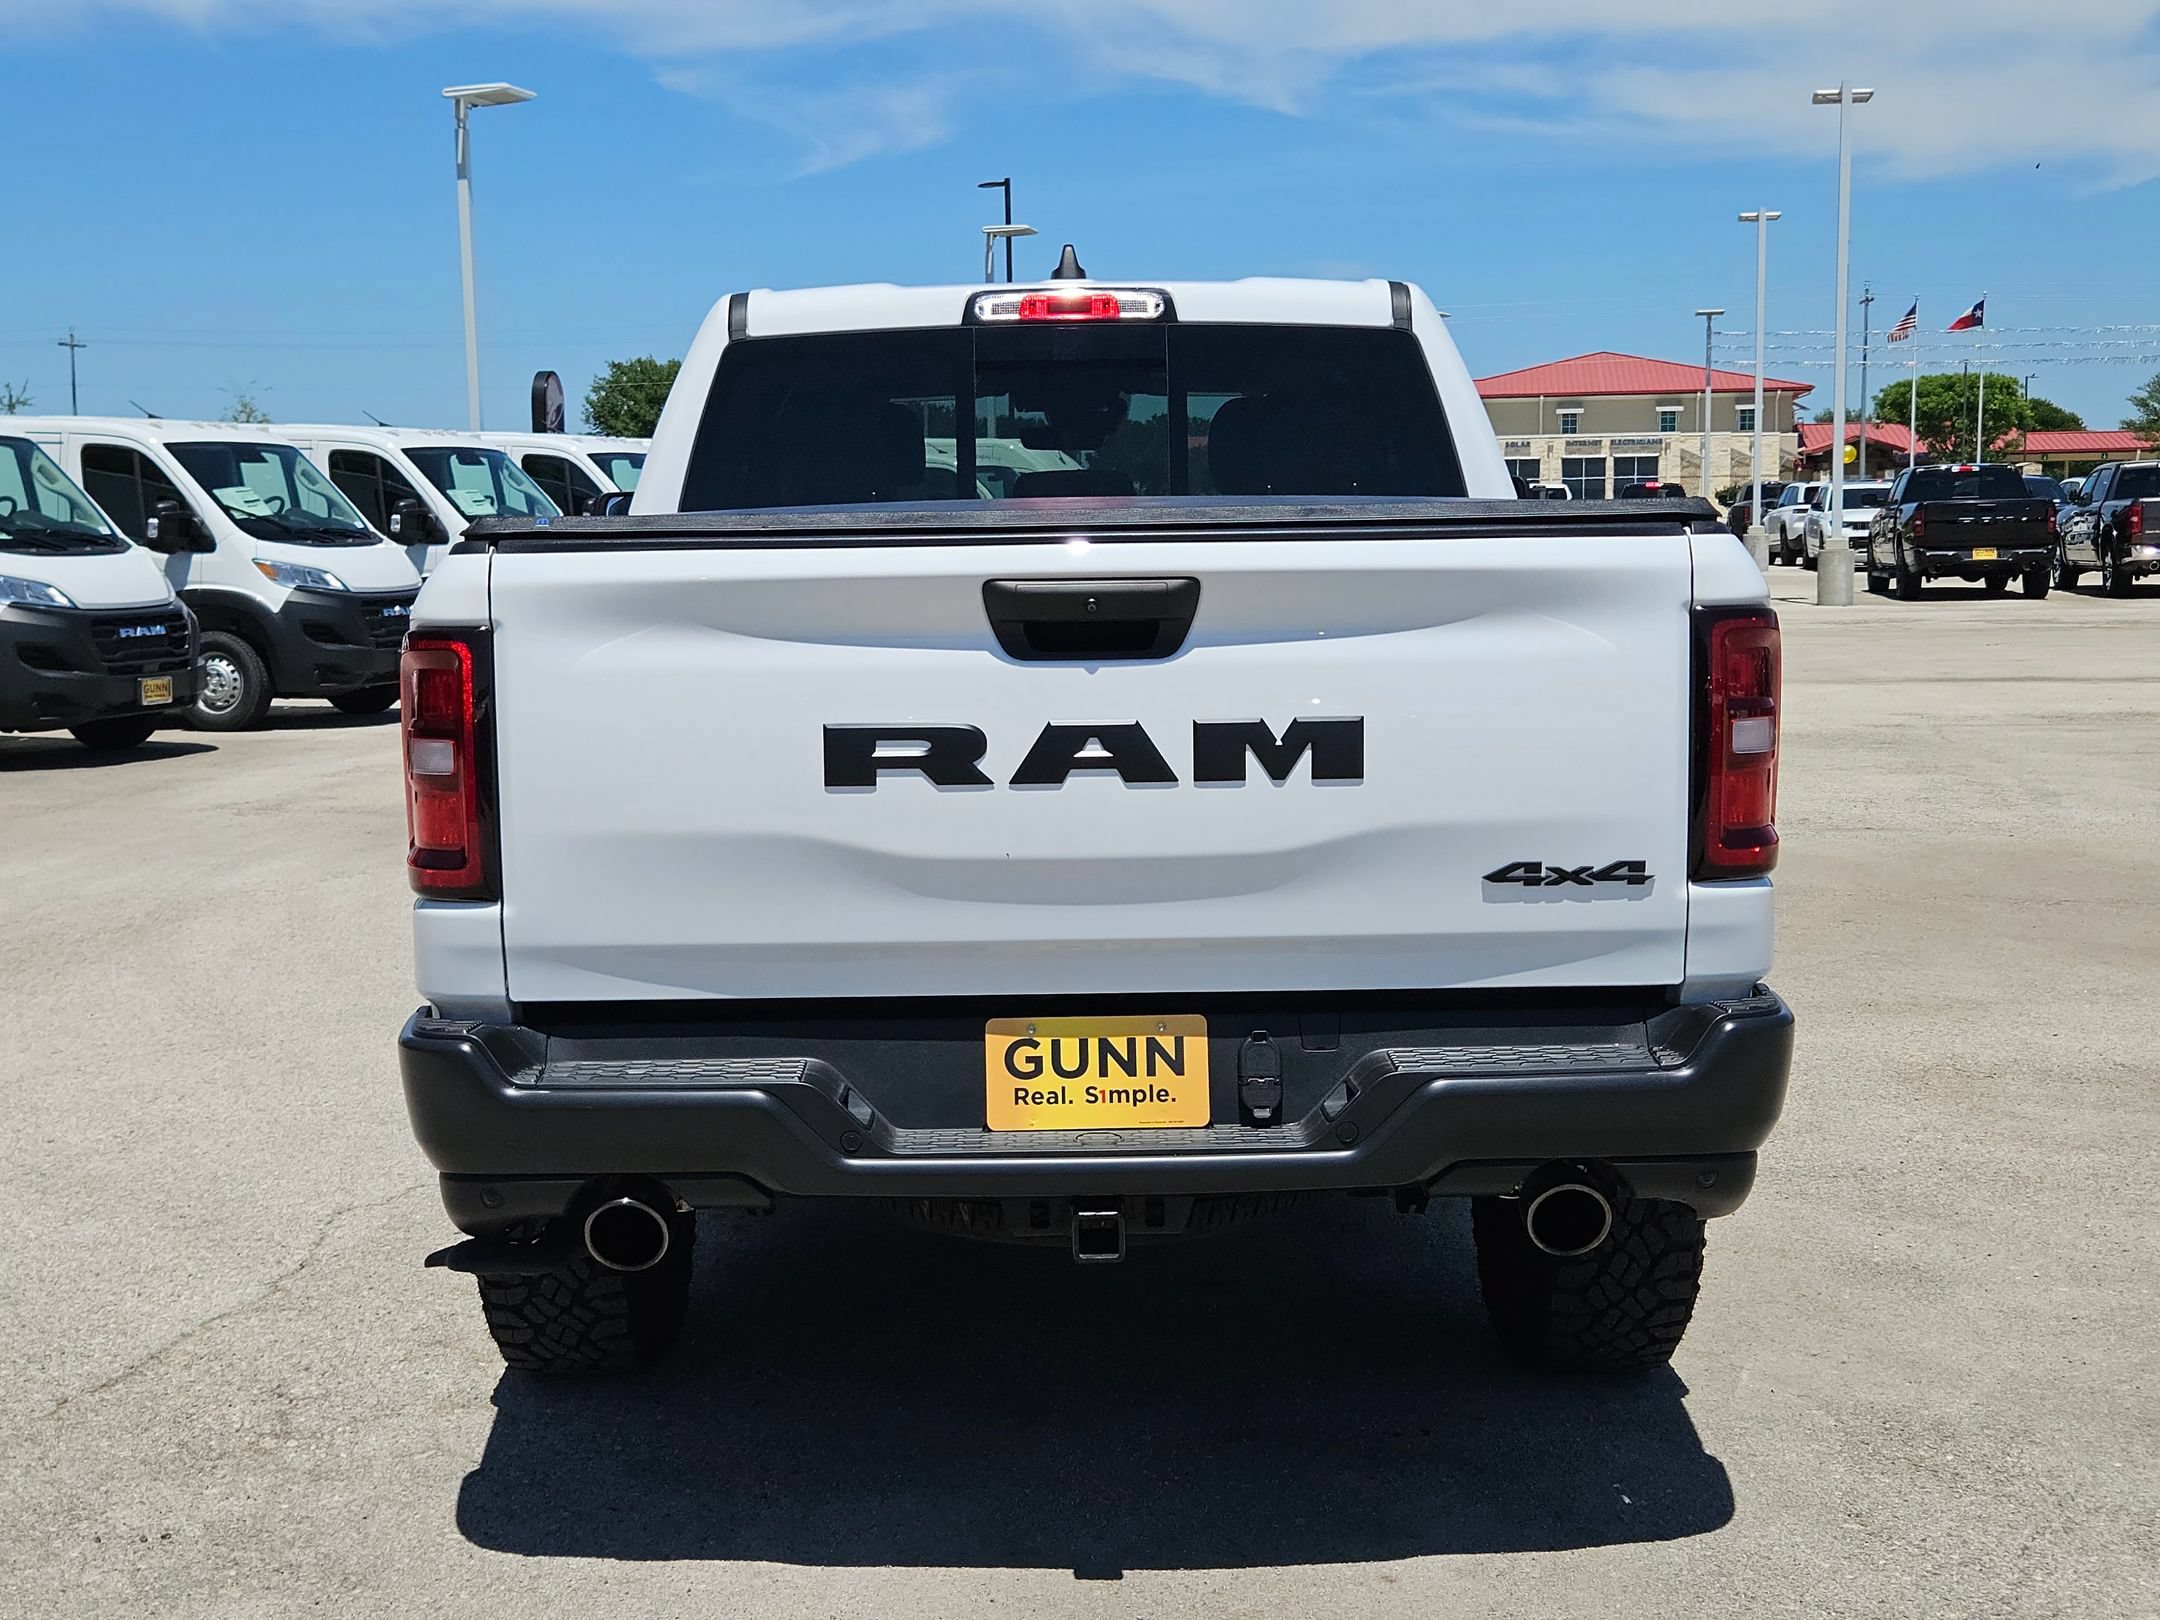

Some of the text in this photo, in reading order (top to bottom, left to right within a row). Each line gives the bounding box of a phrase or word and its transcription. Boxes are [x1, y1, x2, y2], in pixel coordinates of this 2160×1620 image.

[1565, 439, 1603, 447] INTERNET
[1610, 438, 1663, 446] ELECTRICIANS
[119, 624, 167, 638] RAM
[144, 683, 168, 694] GUNN
[823, 716, 1364, 788] RAM
[1481, 860, 1656, 887] 4x4
[1004, 1035, 1186, 1080] GUNN
[1014, 1084, 1177, 1107] Real. S1mple.
